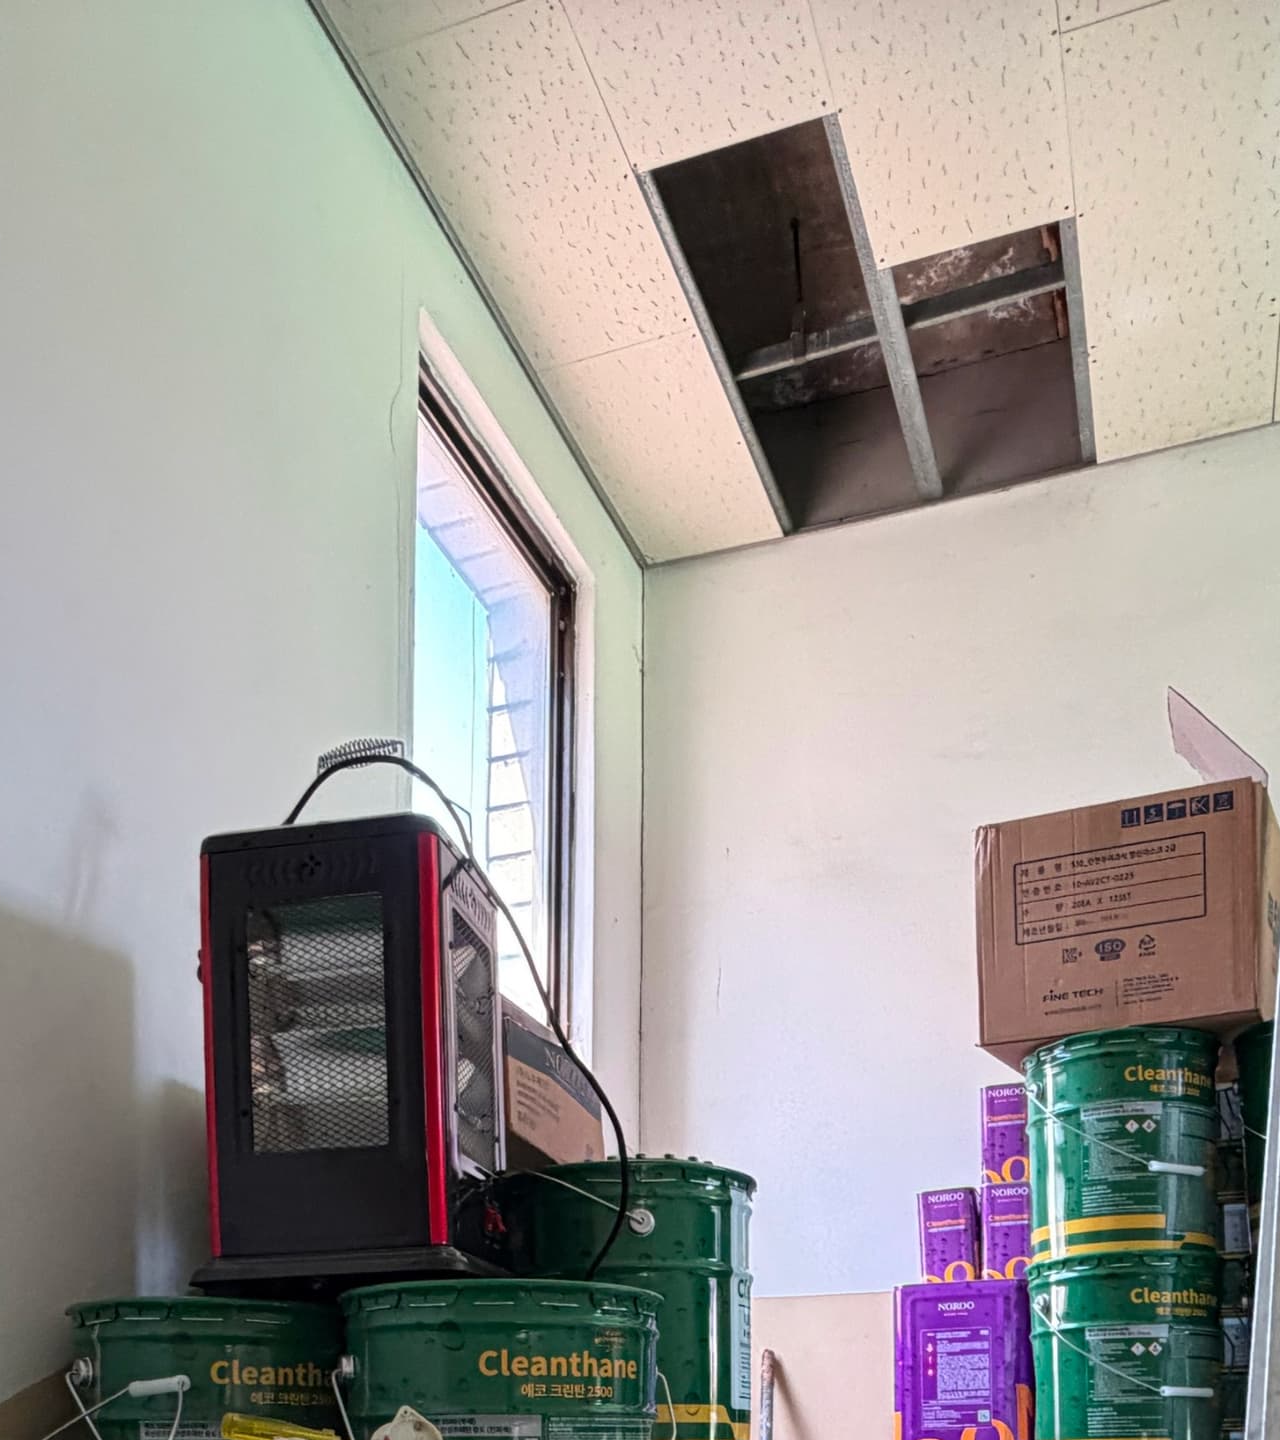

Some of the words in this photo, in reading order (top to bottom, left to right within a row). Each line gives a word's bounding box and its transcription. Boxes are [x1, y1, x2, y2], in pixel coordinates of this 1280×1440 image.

[1072, 987, 1105, 999] TECH
[928, 1191, 964, 1204] NOROO
[991, 1186, 1028, 1198] NOROO
[937, 1301, 975, 1311] NOROO
[478, 1349, 638, 1379] Cleanthane
[521, 1384, 547, 1398] 에코
[550, 1384, 585, 1399] 크린탄
[587, 1385, 614, 1399] 2500
